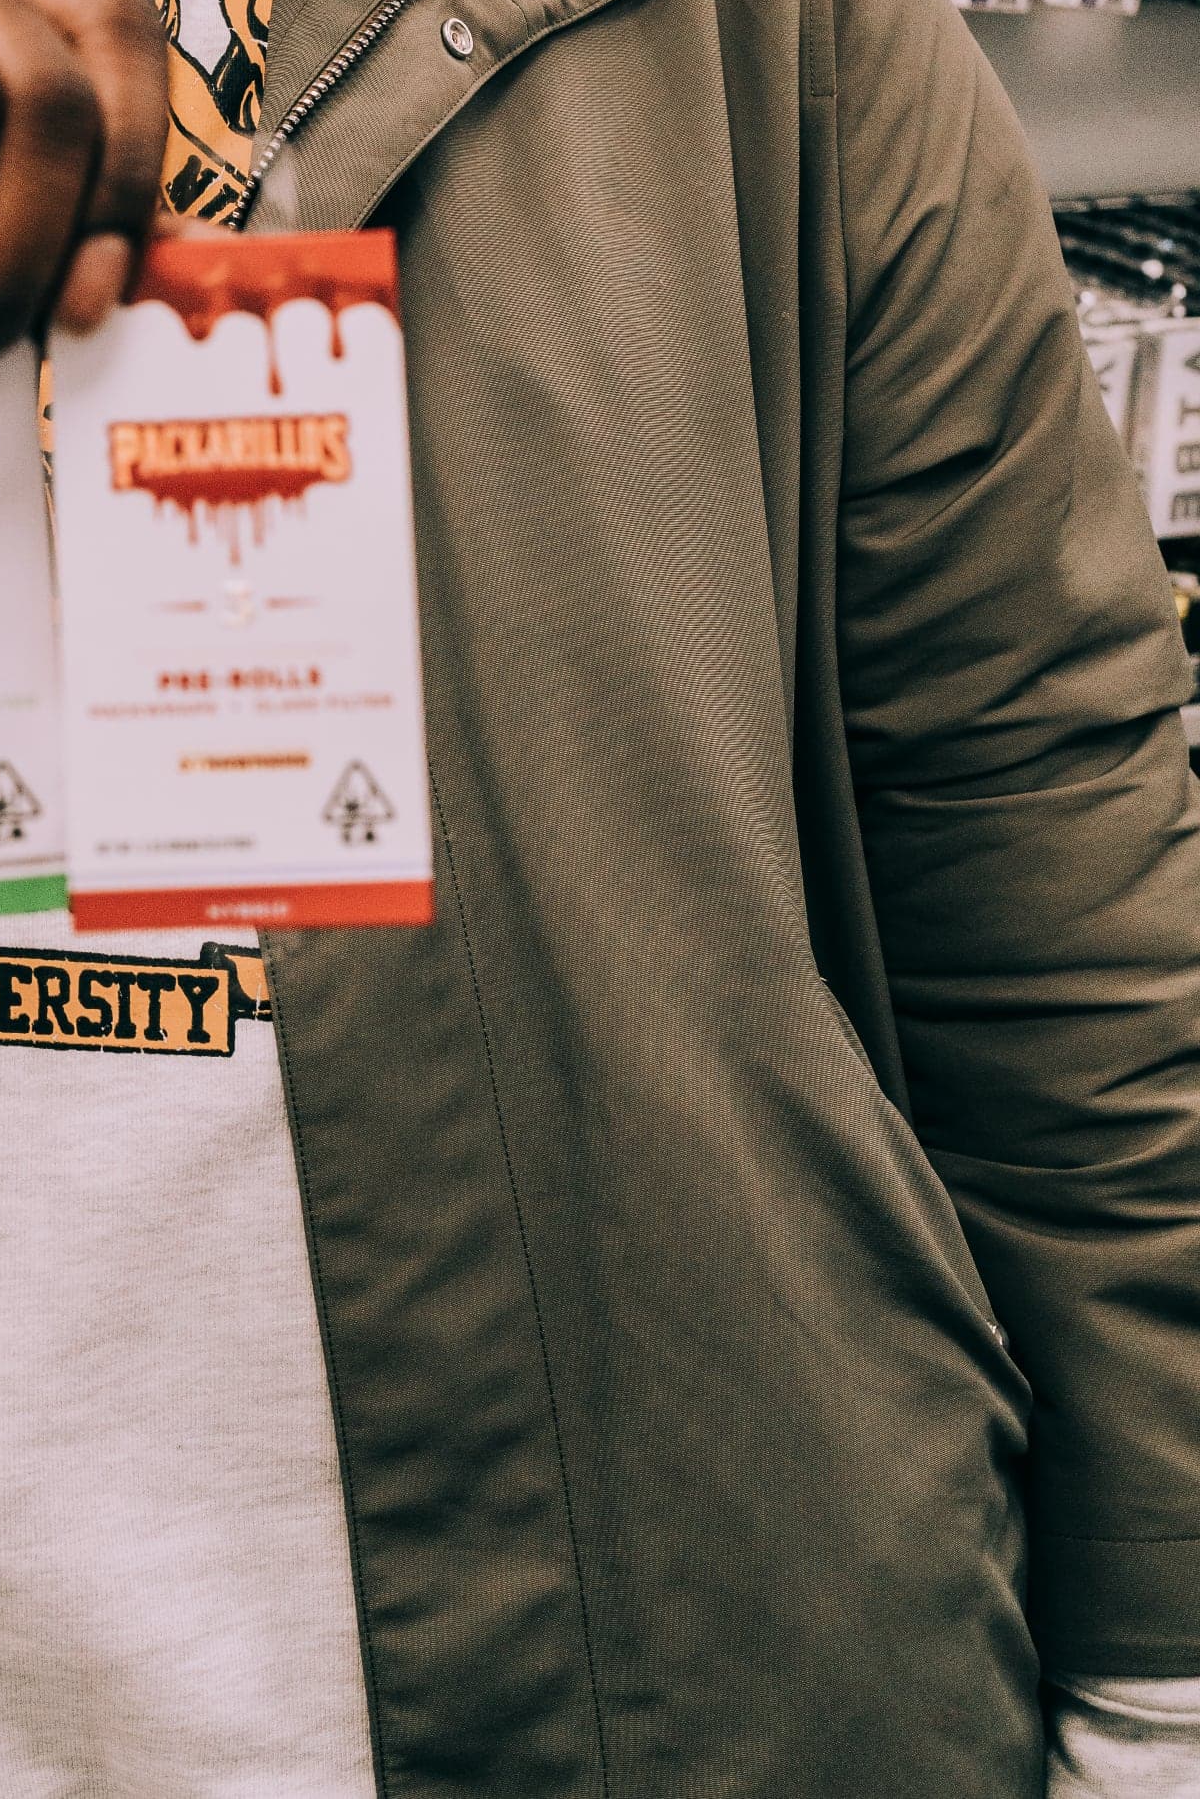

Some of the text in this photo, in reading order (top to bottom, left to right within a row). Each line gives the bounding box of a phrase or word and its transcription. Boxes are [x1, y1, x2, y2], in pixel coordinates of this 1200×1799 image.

[109, 411, 353, 492] PACKARILLOS
[157, 665, 323, 692] PRE-ROLLS
[341, 823, 377, 846] CA
